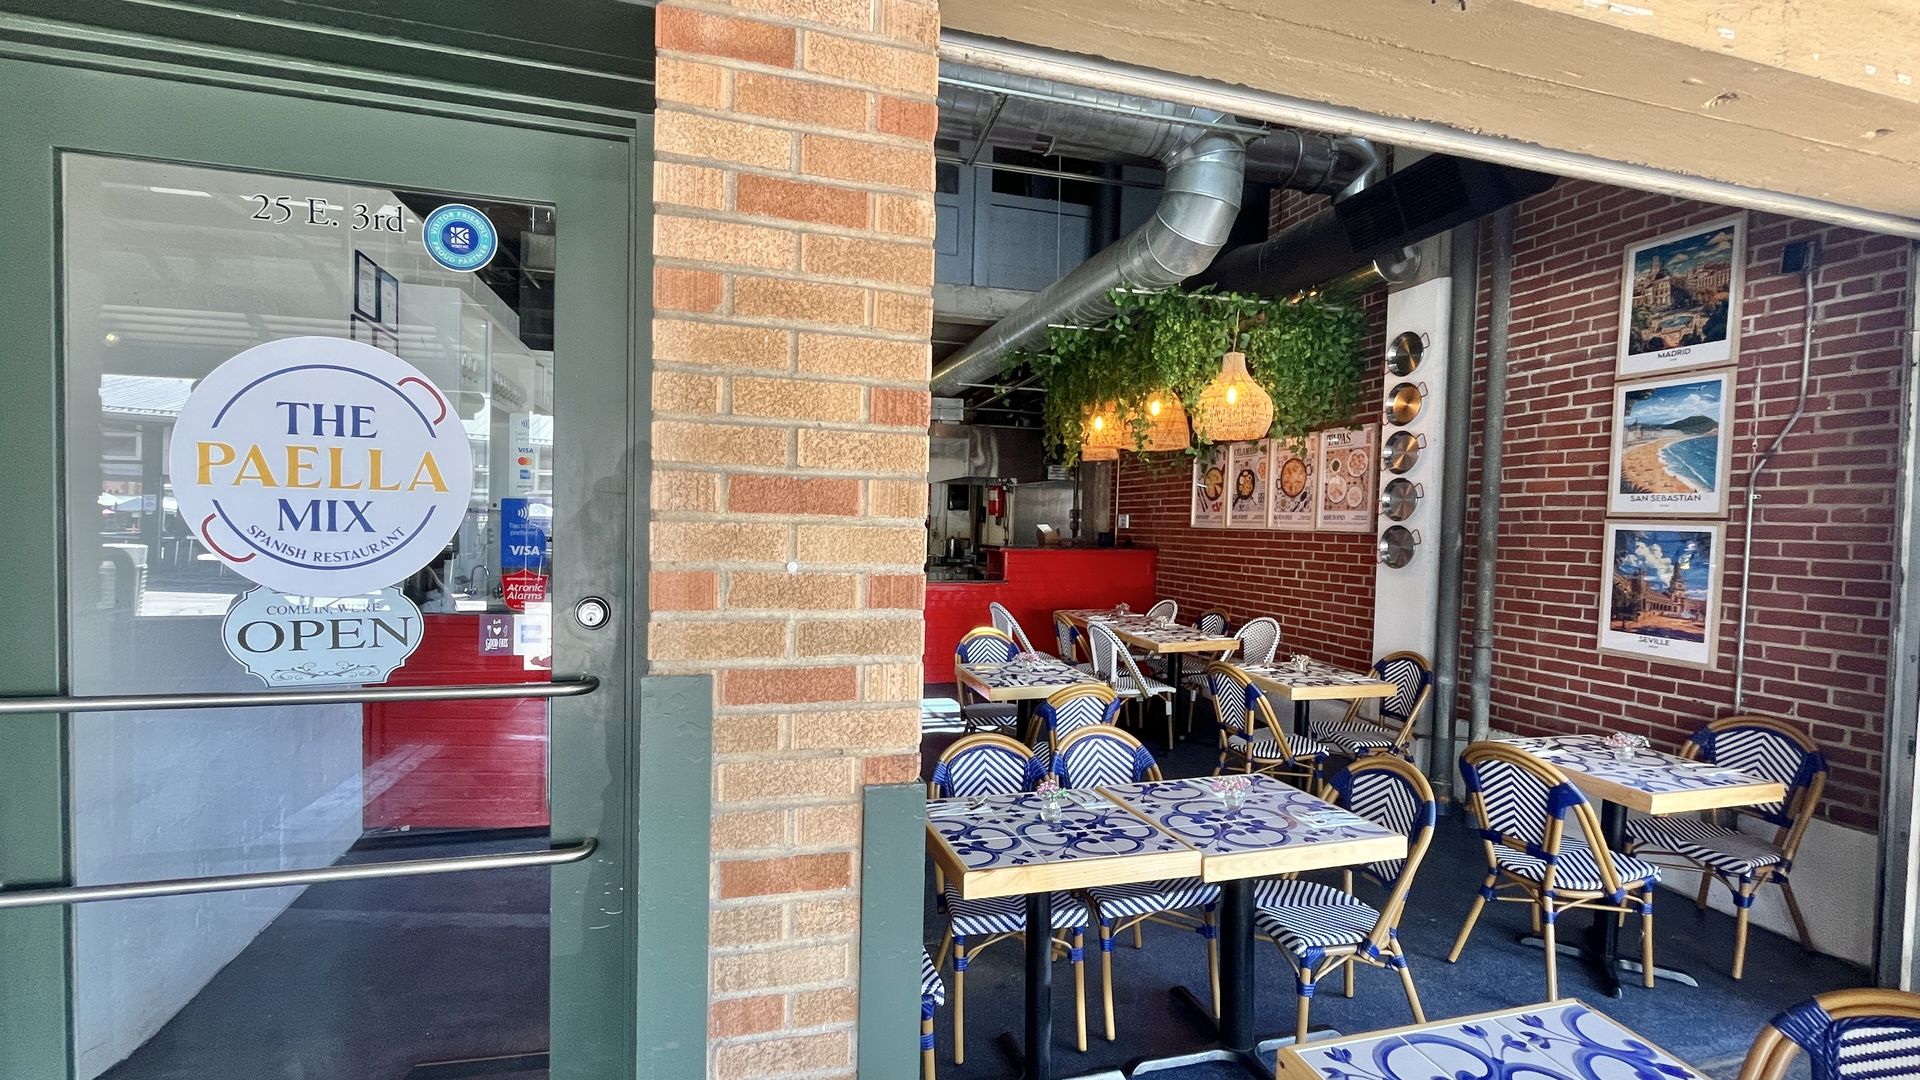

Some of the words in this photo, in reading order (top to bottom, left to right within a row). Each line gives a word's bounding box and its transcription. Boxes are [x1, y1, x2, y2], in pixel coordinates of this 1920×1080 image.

[252, 194, 292, 224] 25
[305, 198, 338, 228] E.
[352, 203, 406, 233] 3rd
[431, 211, 454, 234] VISITOR
[456, 211, 489, 239] FRIENDLY
[431, 241, 456, 263] PROUD
[458, 244, 489, 265] PARTNER
[1657, 347, 1691, 358] MADRID
[276, 401, 377, 439] THE
[195, 441, 449, 493] PAELLA
[1630, 494, 1648, 502] SAN
[1650, 494, 1702, 502] SEBASTIAN
[277, 498, 377, 533] MIX
[246, 524, 307, 560] SPANISH
[313, 525, 406, 562] RESTAURANT
[508, 545, 540, 556] VISA
[506, 583, 544, 592] Atronic
[506, 591, 543, 600] Alarms
[266, 604, 311, 615] COME
[337, 602, 382, 614] WERE
[237, 616, 415, 653] OPEN
[1638, 636, 1670, 647] SEVILLE
